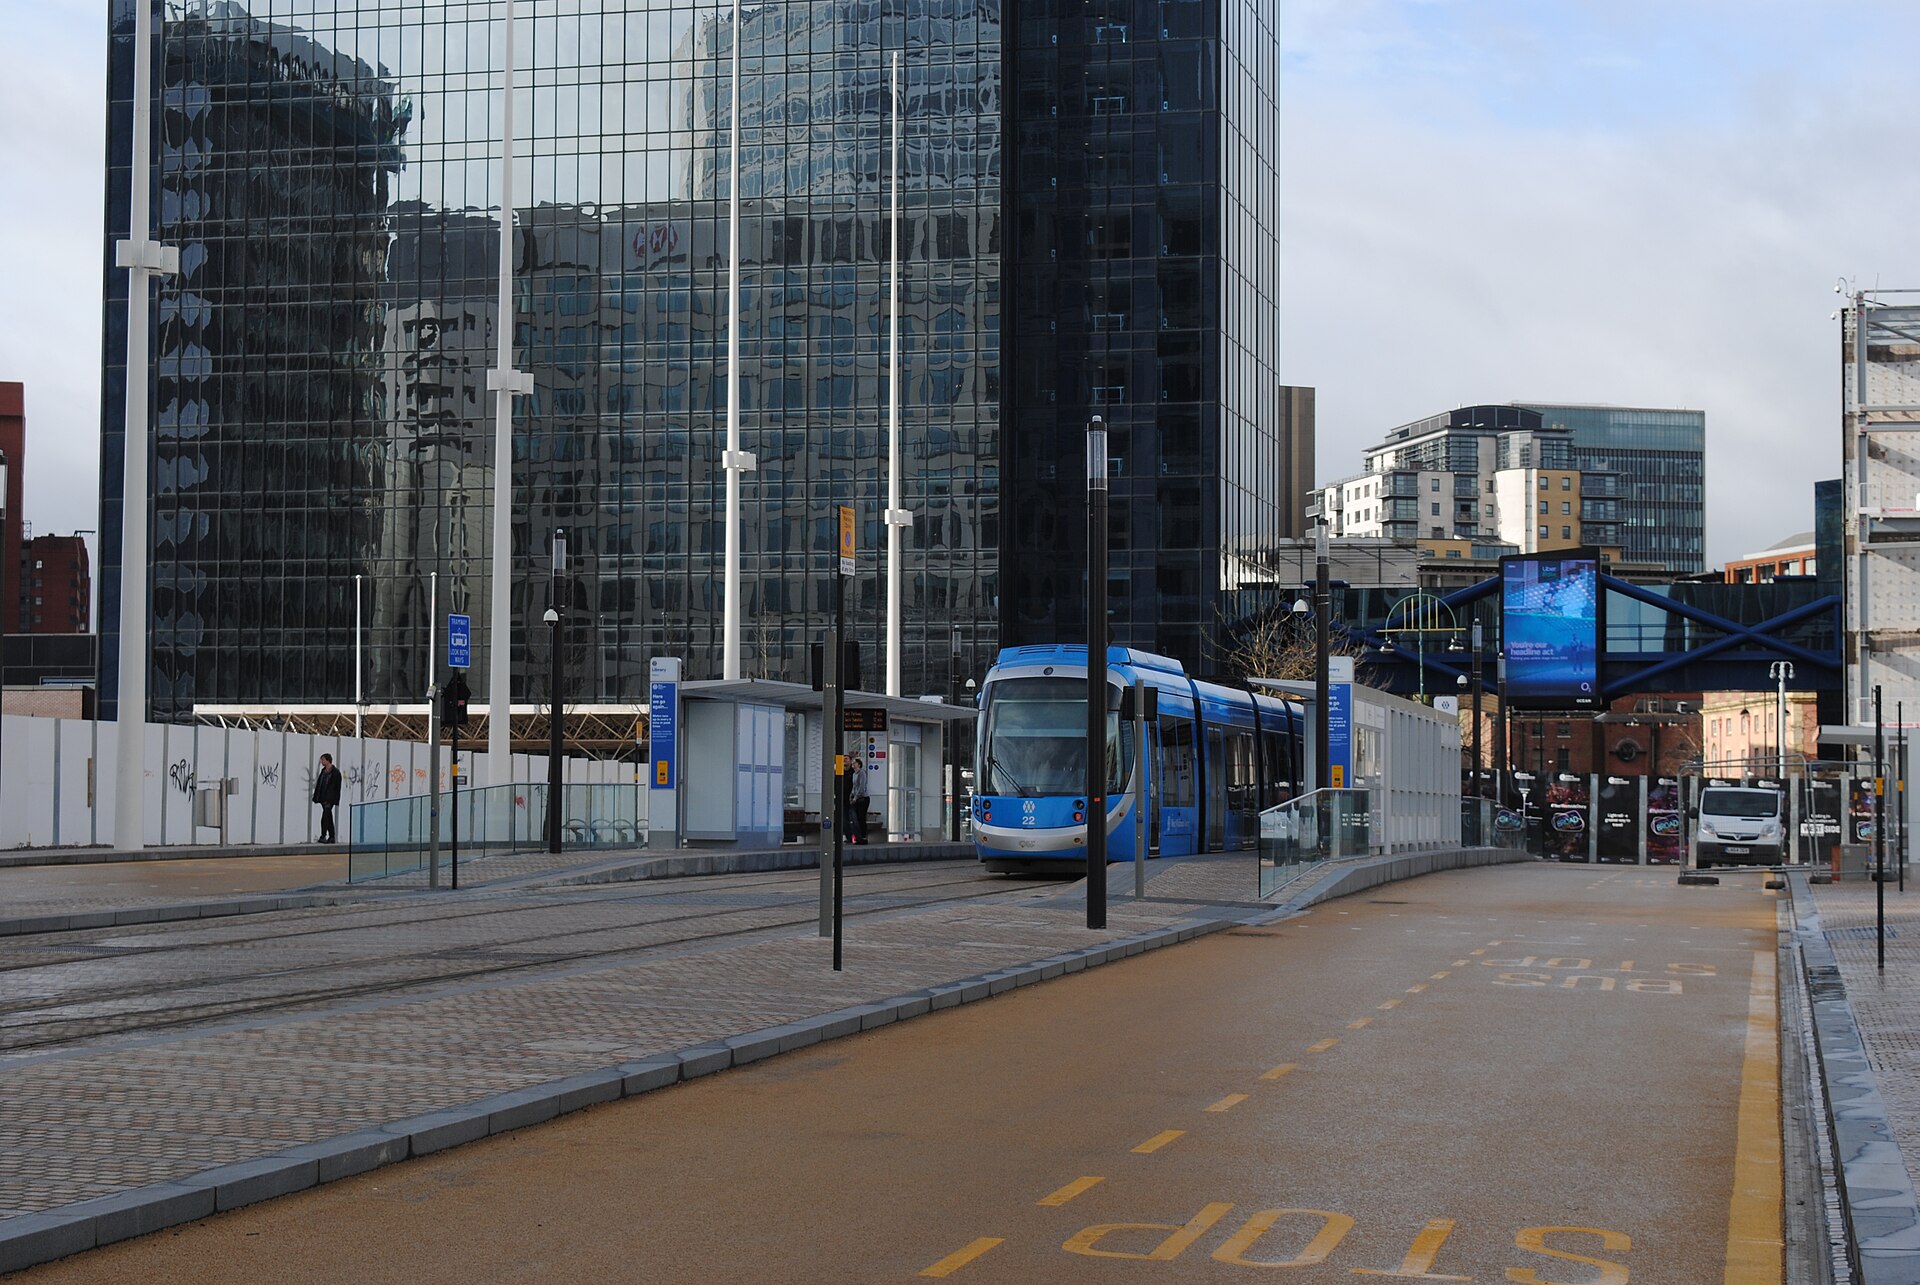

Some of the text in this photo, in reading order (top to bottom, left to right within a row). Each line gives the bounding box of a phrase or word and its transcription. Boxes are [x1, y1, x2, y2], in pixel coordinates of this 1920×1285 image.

[1022, 816, 1035, 825] 22
[1557, 816, 1579, 827] BROAD
[1481, 956, 1716, 976] STOP
[1492, 973, 1683, 994] BUS
[1061, 1202, 1632, 1285] STOP
